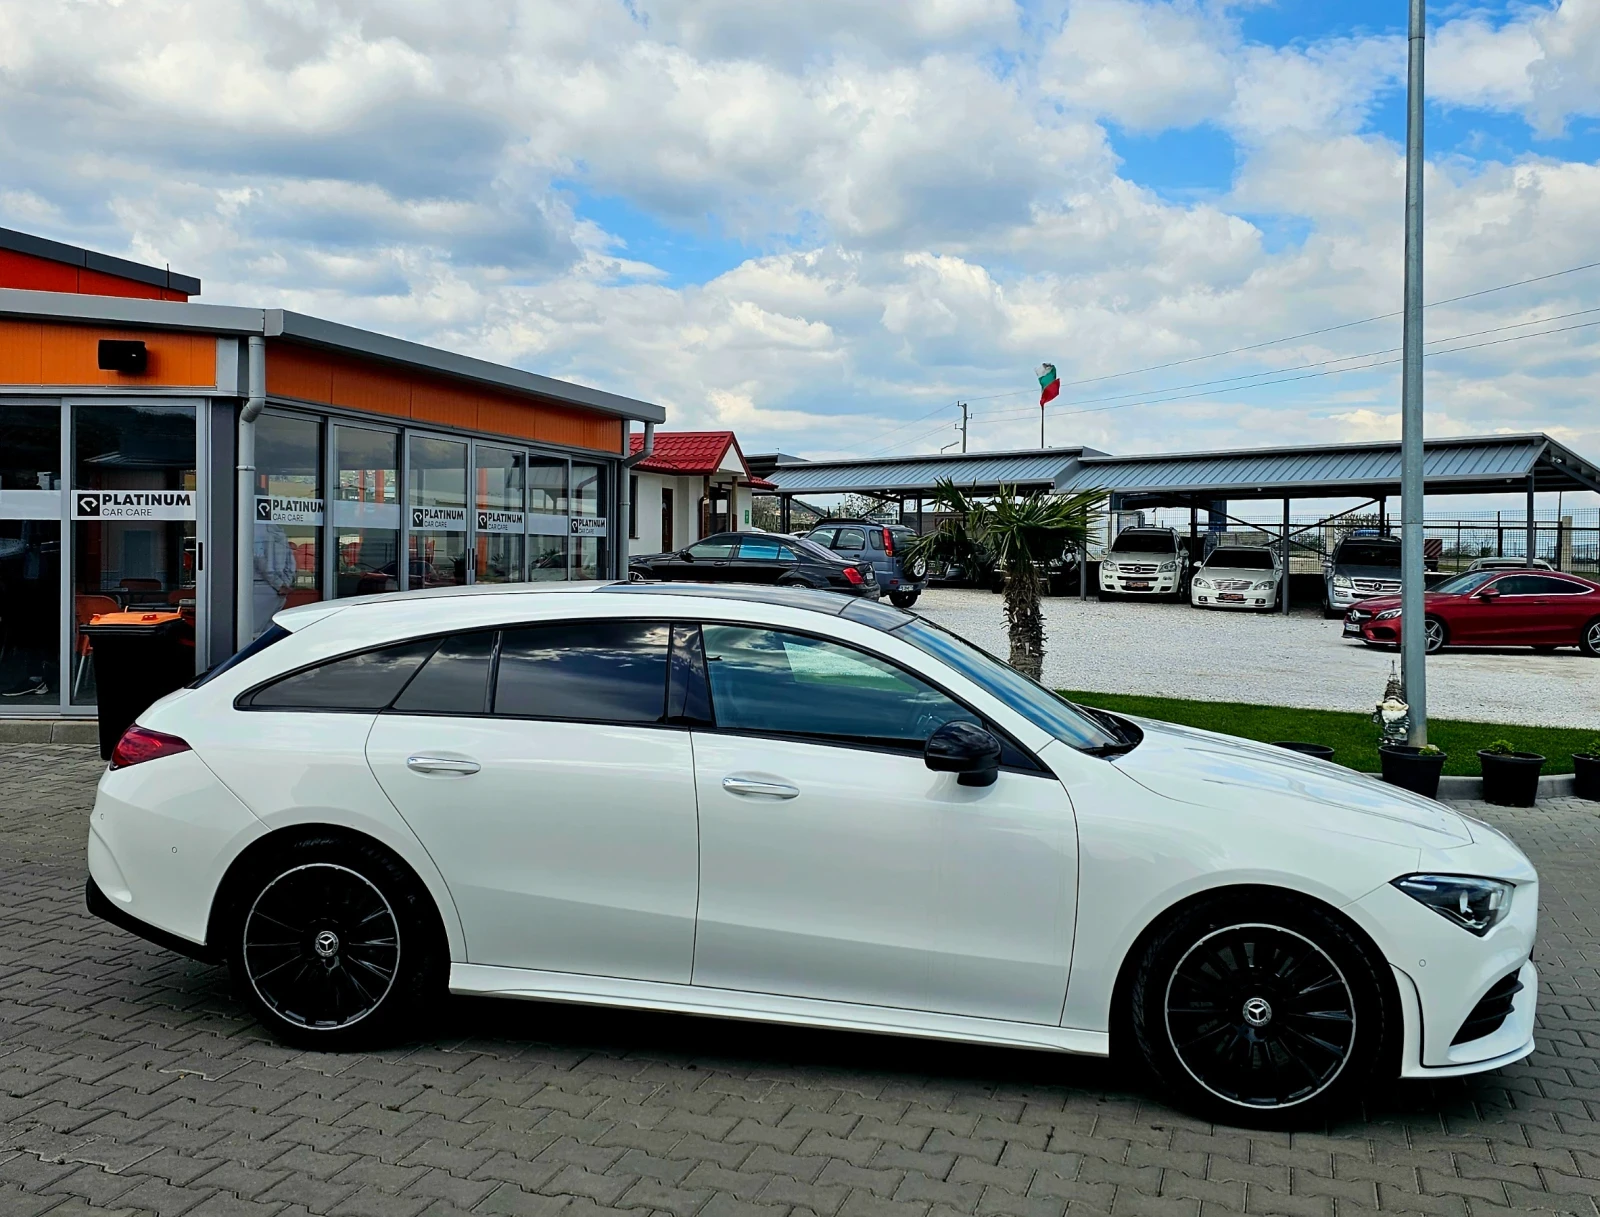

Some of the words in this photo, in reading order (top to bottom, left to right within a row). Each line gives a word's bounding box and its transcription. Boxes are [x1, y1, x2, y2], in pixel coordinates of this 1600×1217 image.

[102, 494, 190, 506] PLATINUM
[102, 508, 122, 516] CAR
[126, 508, 152, 516] CARE
[424, 508, 464, 520] PLATINUM
[272, 513, 286, 521] CAR
[288, 514, 304, 522] CARE
[488, 513, 522, 523] PLATINUM
[579, 519, 605, 528] PLATINUM
